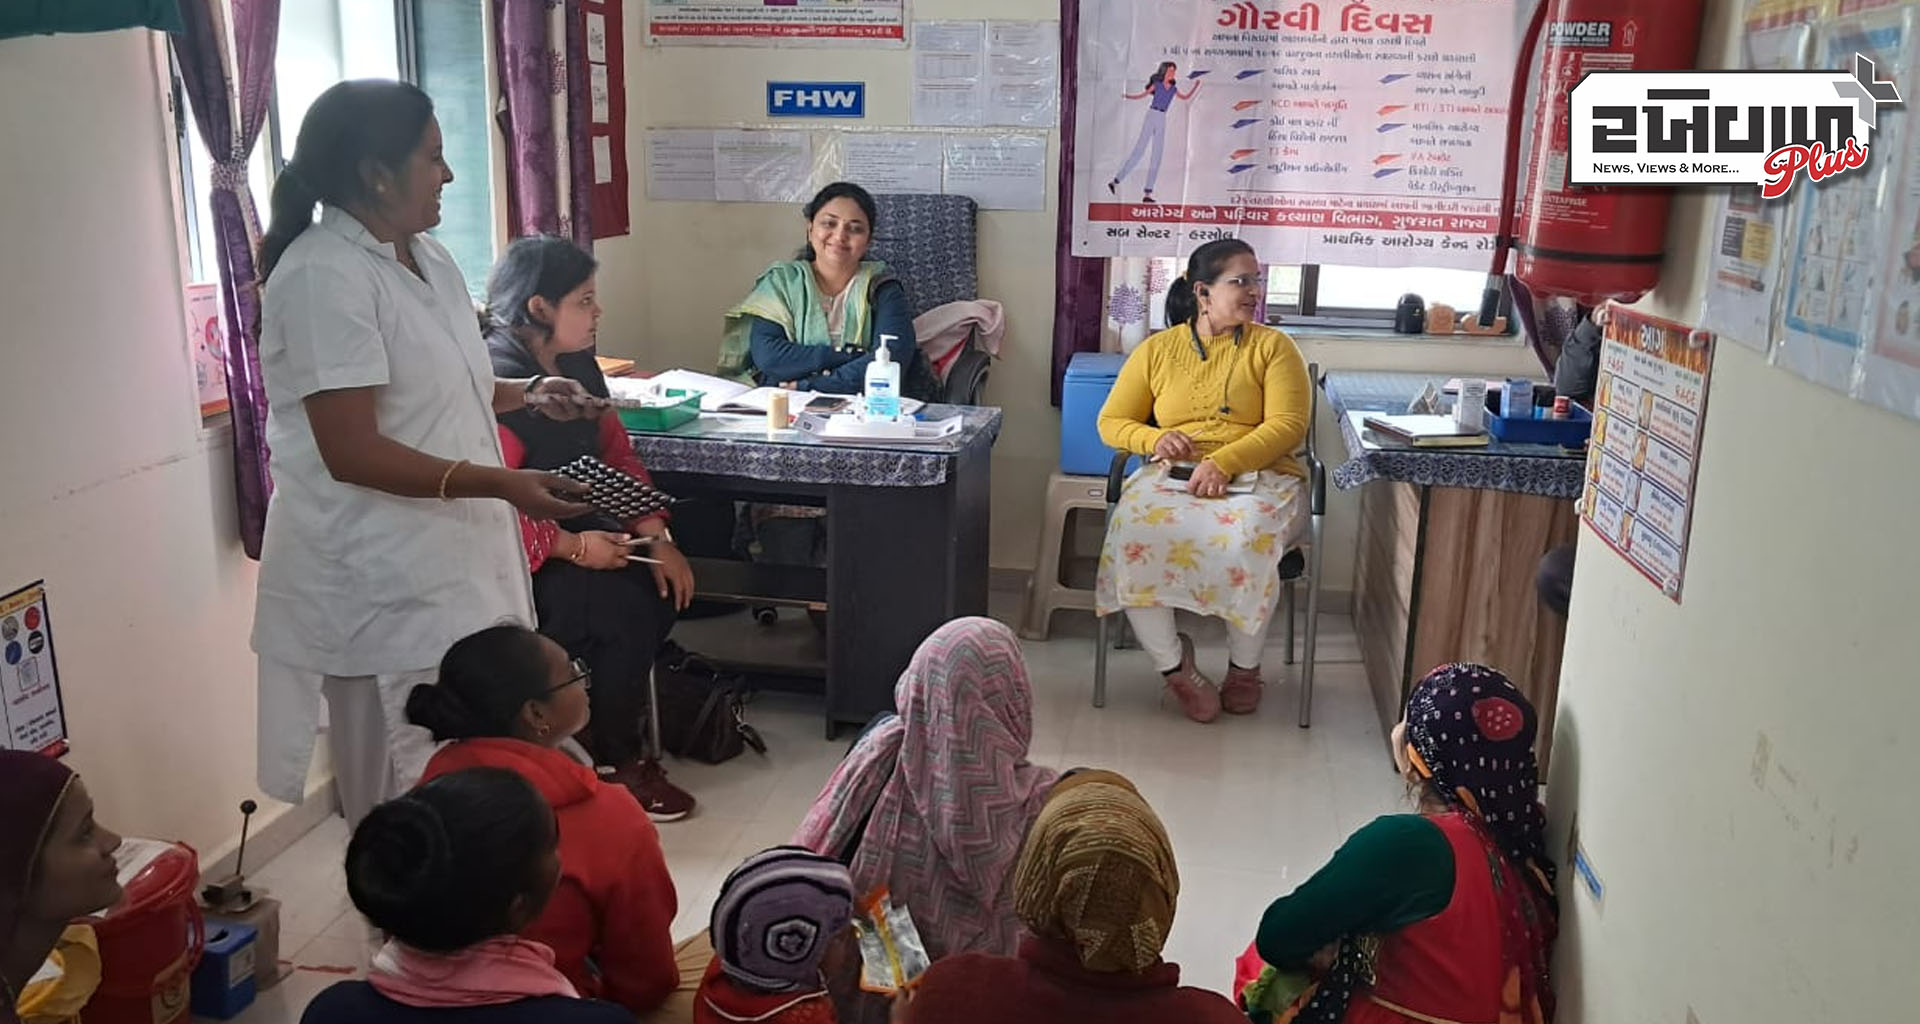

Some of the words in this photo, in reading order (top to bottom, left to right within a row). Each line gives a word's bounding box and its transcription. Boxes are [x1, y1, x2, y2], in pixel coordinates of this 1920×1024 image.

[1217, 1, 1320, 31] ગૌરવી
[1341, 2, 1432, 34] દિવસ
[774, 90, 857, 108] FHW
[1131, 205, 1184, 219] આરોગ્ય
[1190, 205, 1217, 220] અને
[1223, 207, 1269, 221] પરિવાર
[1276, 210, 1324, 224] કલ્યાણ
[1331, 210, 1383, 227] વિભાગ,
[1391, 216, 1444, 230] ગુજરાત
[1450, 217, 1488, 229] રાજ્ય
[1106, 227, 1130, 238] સબ
[1136, 225, 1171, 239] સેન્ટર
[1322, 231, 1375, 246] પ્રાથમિક
[1381, 233, 1434, 248] આરોગ્ય
[1441, 235, 1469, 250] કેન્દ્ર
